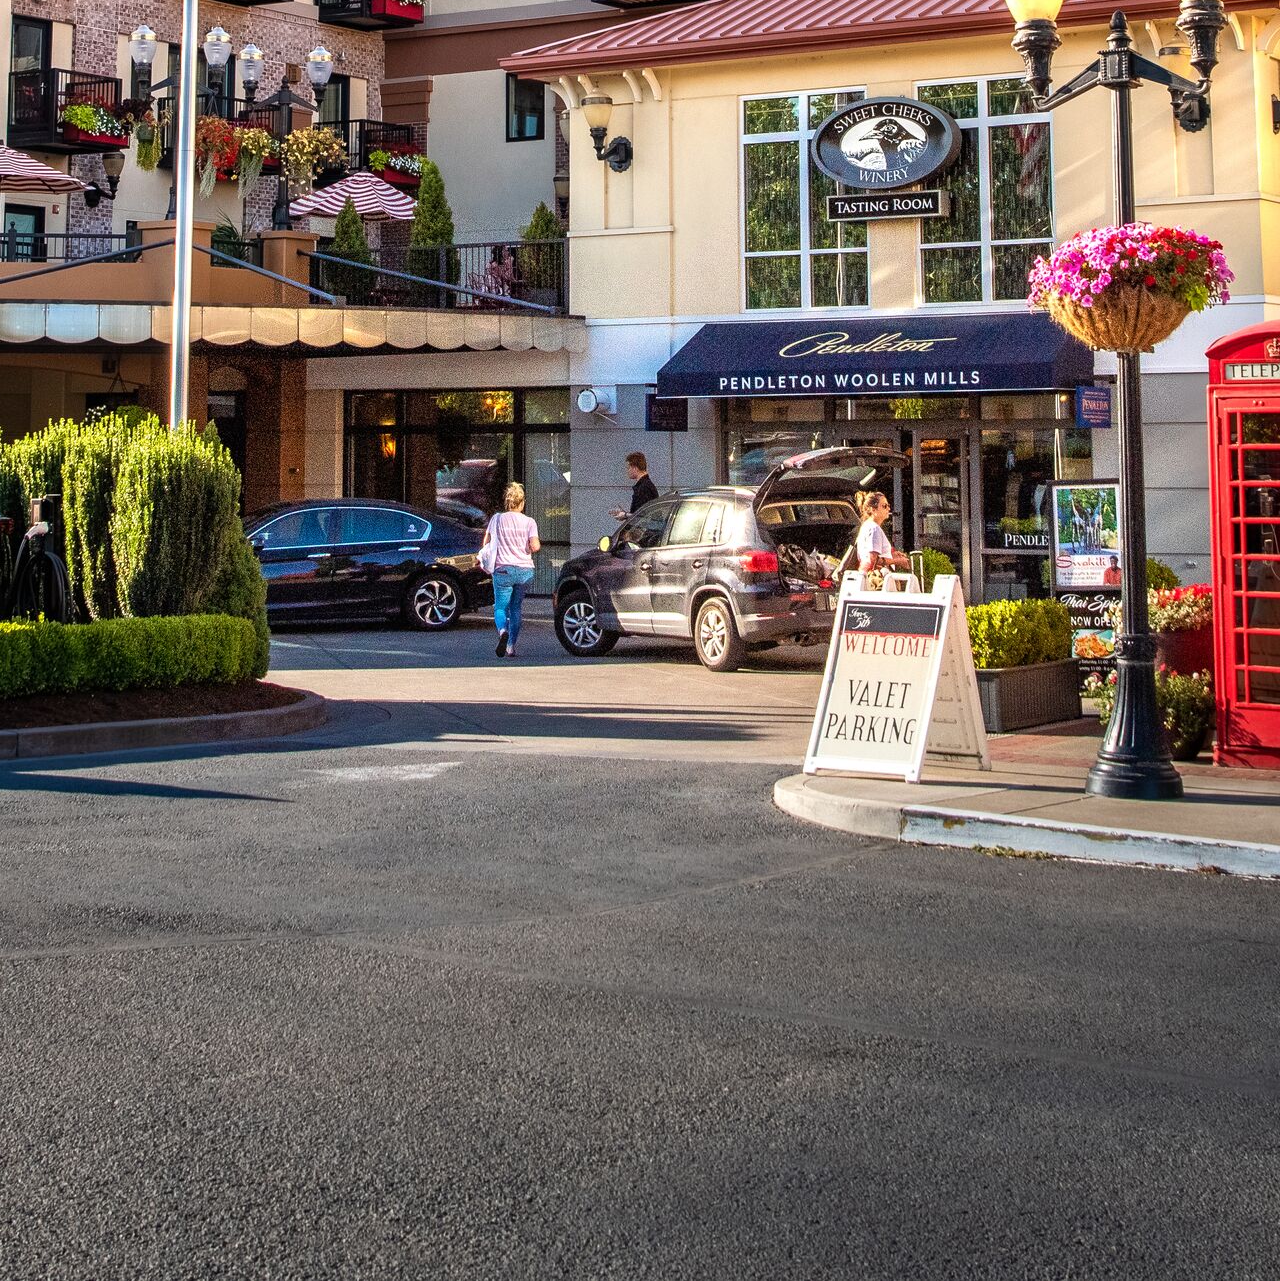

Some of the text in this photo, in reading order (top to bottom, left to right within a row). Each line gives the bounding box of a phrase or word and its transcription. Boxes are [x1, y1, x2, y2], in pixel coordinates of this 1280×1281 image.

[834, 104, 934, 134] SWEET CHEEKS
[859, 166, 909, 183] WINERY
[834, 198, 934, 214] TASTING ROOM
[778, 332, 958, 358] Pendleton
[719, 371, 980, 390] PENDLETON WOOLEN MILLS
[1060, 594, 1088, 609] Thai
[1070, 616, 1091, 627] NOW
[845, 634, 932, 658] WELCOME
[849, 679, 911, 709] VALET
[824, 712, 917, 745] PARKING
